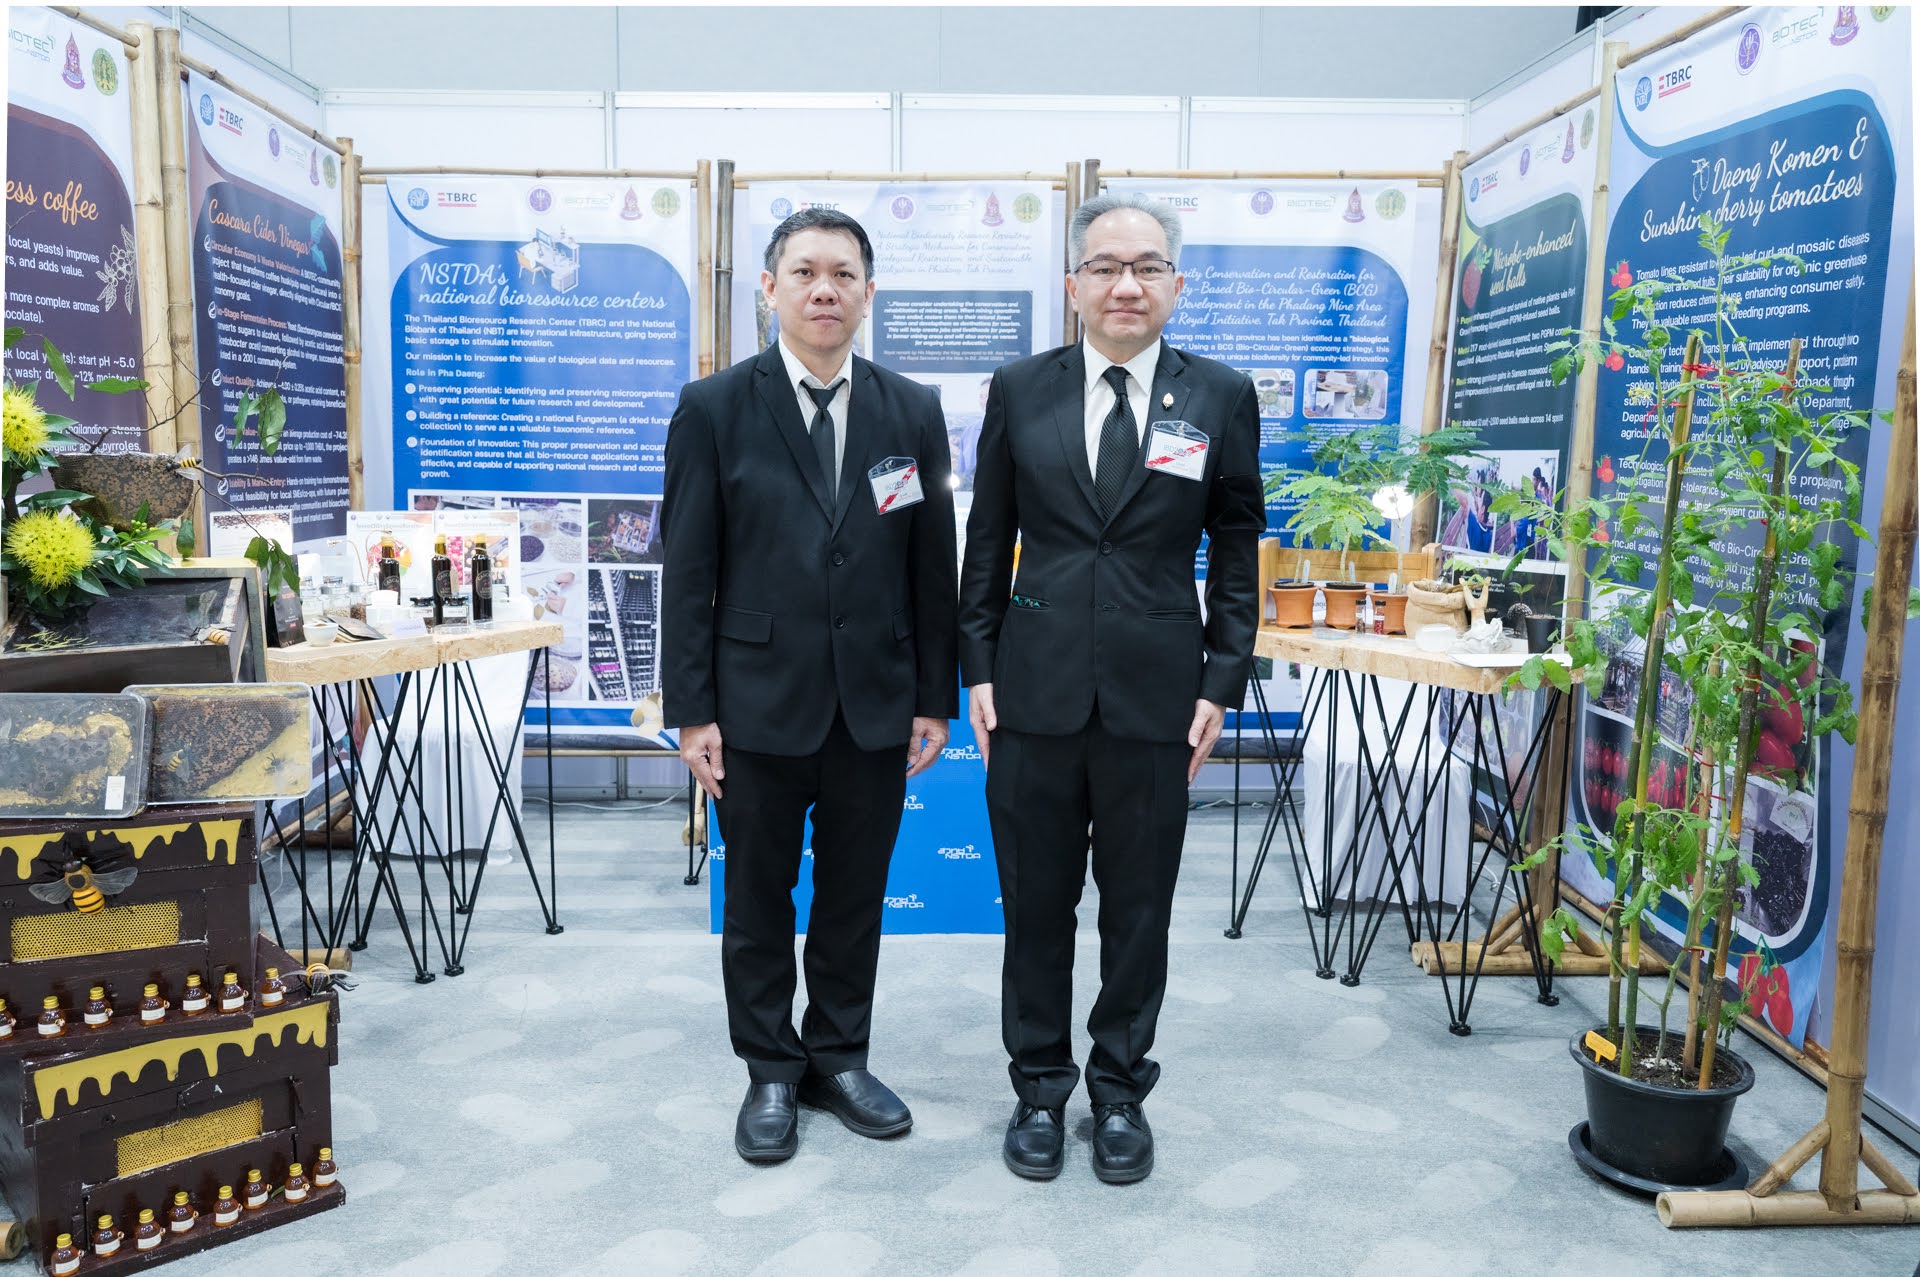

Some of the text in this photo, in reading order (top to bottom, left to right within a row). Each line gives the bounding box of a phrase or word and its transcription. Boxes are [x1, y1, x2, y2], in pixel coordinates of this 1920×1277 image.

[1665, 66, 1692, 89] TBRC
[225, 110, 244, 130] TBRC
[1712, 117, 1868, 195] Daeng Komen &
[43, 180, 98, 225] coffee
[446, 192, 477, 202] TBRC
[1168, 197, 1198, 207] TBRC
[1714, 190, 1765, 226] cherry
[1770, 170, 1863, 212] tomatoes
[208, 198, 309, 258] Cascara Cider Vinegar
[8, 234, 100, 264] local yeasts) improves
[1492, 218, 1576, 274] Microbe-enhanced
[19, 258, 84, 277] and adds value.
[1637, 266, 1659, 280] Tomato
[1661, 264, 1677, 276] lines
[1679, 260, 1708, 274] resistant
[1797, 238, 1835, 254] mosaic
[419, 263, 509, 286] NSTDA's
[1206, 266, 1375, 283] Conservation and Restoration for
[1490, 262, 1526, 297] seed balls
[1736, 266, 1770, 282] suitability
[1773, 265, 1784, 277] for
[1786, 260, 1822, 277] orgnic
[418, 285, 667, 309] national bioresource centers
[1236, 281, 1378, 296] Bio-Circular-Green (BCG)
[1670, 296, 1697, 308] reduces
[1745, 284, 1788, 300] enhancing
[1790, 278, 1843, 294] consumer
[10, 292, 100, 314] more complex aromas
[1176, 295, 1381, 313] Development in the Phadang Mine Area
[405, 314, 420, 325] The
[423, 315, 457, 323] Thailand
[460, 316, 507, 324] Bioresource
[509, 317, 546, 325] Research
[579, 318, 606, 327] (TBRC)
[1178, 310, 1210, 328] Royal
[1268, 313, 1286, 326] Tak
[1339, 314, 1387, 327] Thailand
[1633, 318, 1649, 330] They
[1661, 314, 1690, 326] valuable
[1691, 310, 1717, 322] resources
[1766, 302, 1811, 318] programs.
[405, 324, 437, 334] Biobank
[449, 326, 481, 334] Thailand
[483, 327, 505, 336] (NBT)
[520, 328, 534, 337] key
[570, 329, 622, 339] infrastructure,
[624, 331, 646, 340] going
[648, 331, 676, 340] beyond
[16, 349, 136, 369] local start pH ~5.0
[474, 354, 507, 362] increase
[559, 356, 596, 366] biological
[15, 368, 42, 381] wash;
[1260, 462, 1288, 472] Impact
